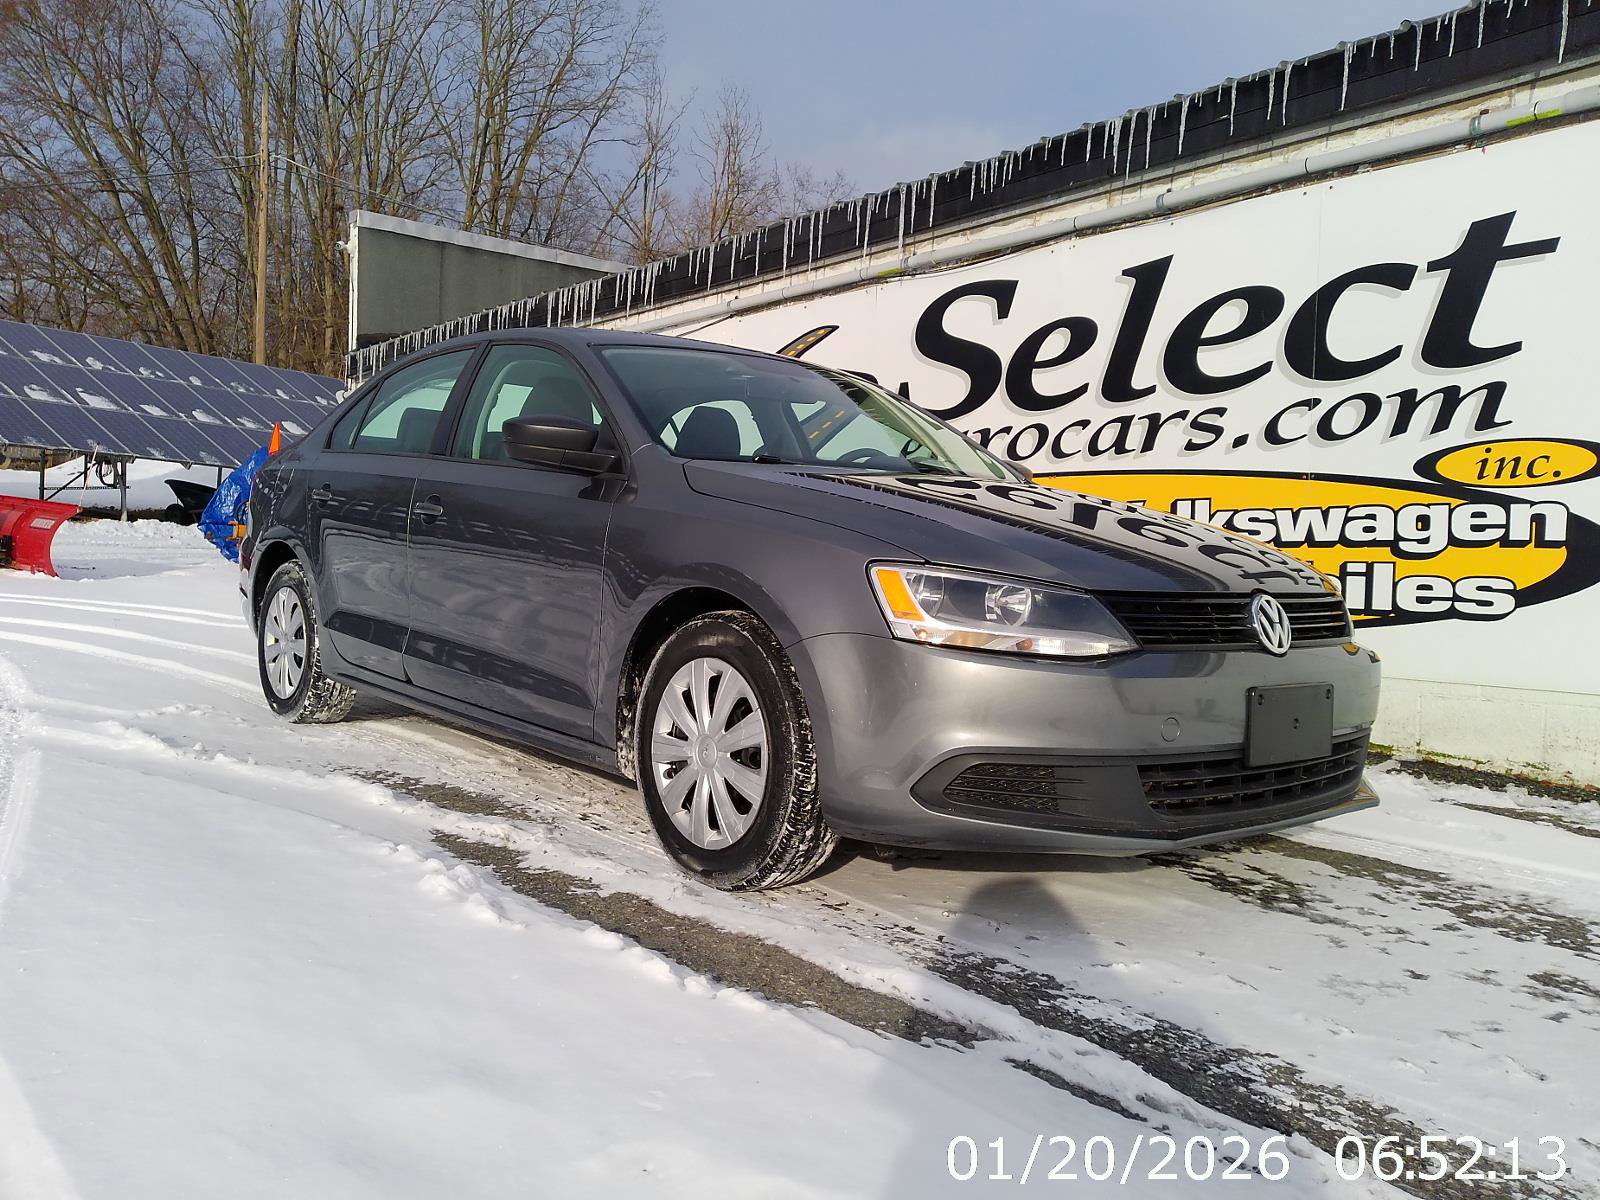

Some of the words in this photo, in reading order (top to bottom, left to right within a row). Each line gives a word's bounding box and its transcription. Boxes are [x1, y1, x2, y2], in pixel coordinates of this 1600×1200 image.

[898, 210, 1560, 422] Select
[962, 380, 1513, 462] rocars.com
[1475, 446, 1562, 481] inc.
[1127, 498, 1568, 560] kswagen
[1306, 560, 1518, 617] iles
